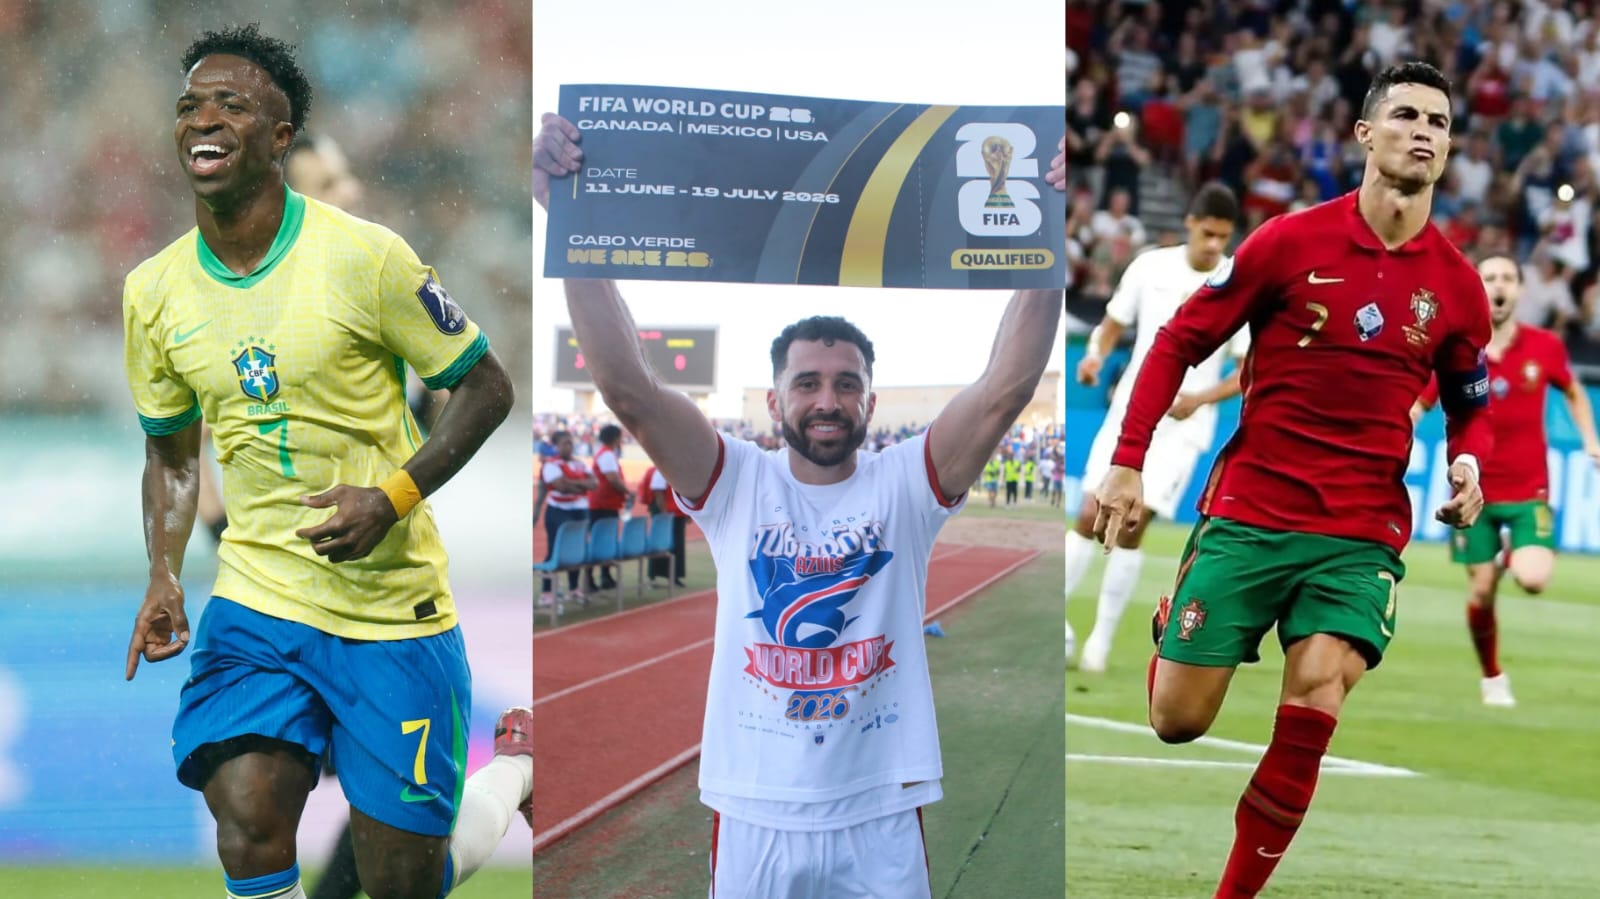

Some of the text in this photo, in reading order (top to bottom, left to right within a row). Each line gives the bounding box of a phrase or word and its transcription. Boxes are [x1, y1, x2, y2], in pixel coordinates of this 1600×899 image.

[579, 96, 628, 113] FIFA
[633, 97, 716, 117] WORLD
[720, 102, 765, 120] CUP
[577, 120, 829, 142] CANADA MEXICO USA
[587, 168, 637, 179] DATE
[585, 182, 610, 193] 11
[615, 183, 675, 196] JUNE
[691, 186, 720, 198] 19
[723, 188, 777, 200] JULY
[782, 191, 840, 204] 2026
[983, 213, 1021, 226] FIFA
[568, 234, 696, 248] CABO VERDE
[567, 248, 606, 264] WE
[611, 249, 662, 266] ARE
[960, 253, 1046, 268] QUALIFIED
[1297, 302, 1328, 347] 7
[248, 370, 265, 378] CBF
[247, 402, 290, 416] BRASIL
[258, 418, 296, 478] 7
[750, 520, 887, 561] TUBARÕES
[794, 556, 845, 575] AZUIS
[753, 637, 885, 685] WORLD CUP
[785, 685, 859, 721] 2026
[401, 718, 430, 785] 7
